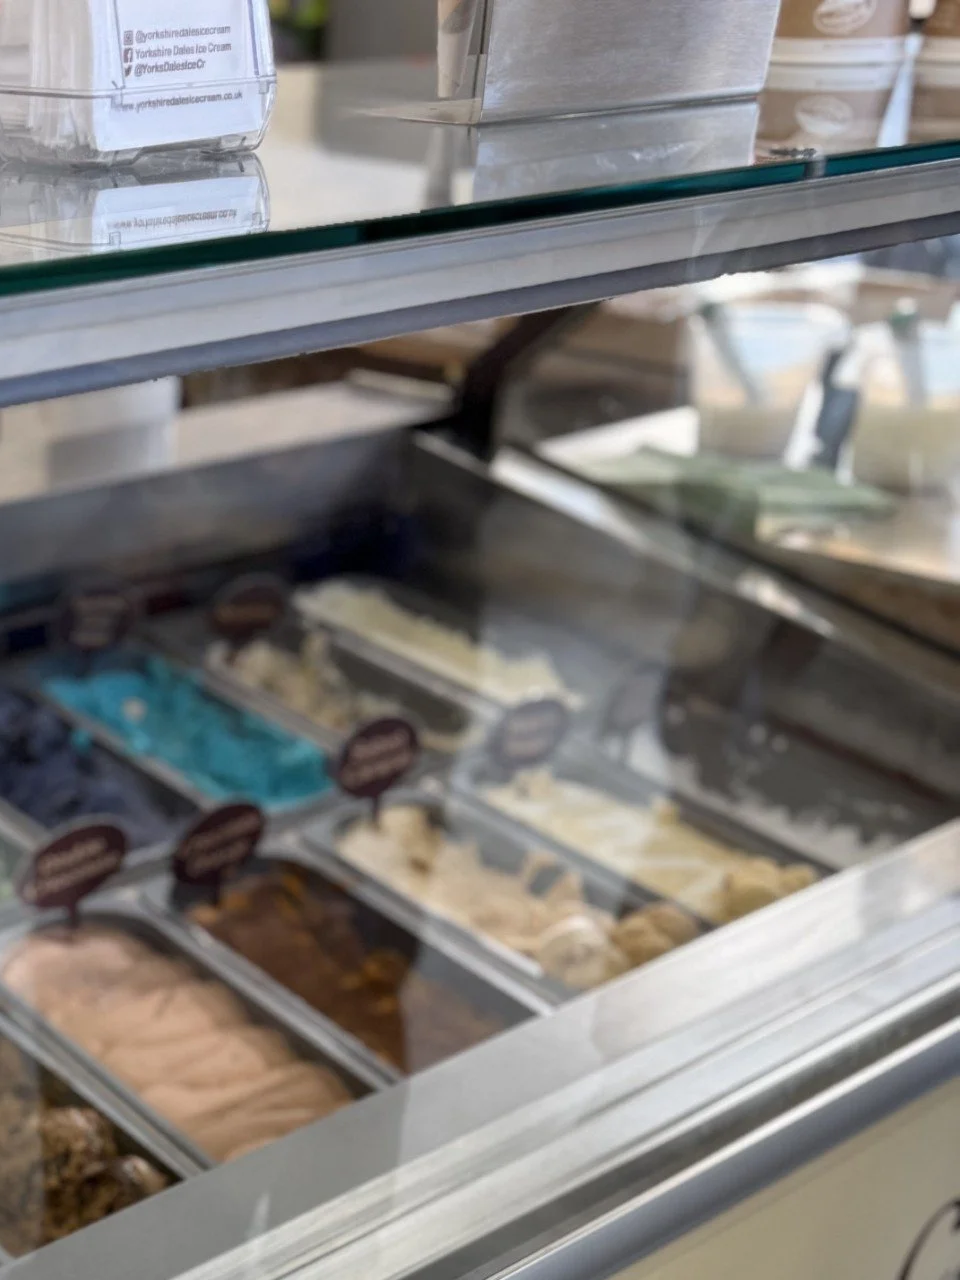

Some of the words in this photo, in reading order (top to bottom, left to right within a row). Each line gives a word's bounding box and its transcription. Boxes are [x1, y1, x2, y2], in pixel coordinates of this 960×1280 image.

[135, 45, 172, 60] Yorkshire
[173, 44, 194, 56] Dales
[196, 43, 207, 54] Ice
[208, 42, 232, 53] Cream
